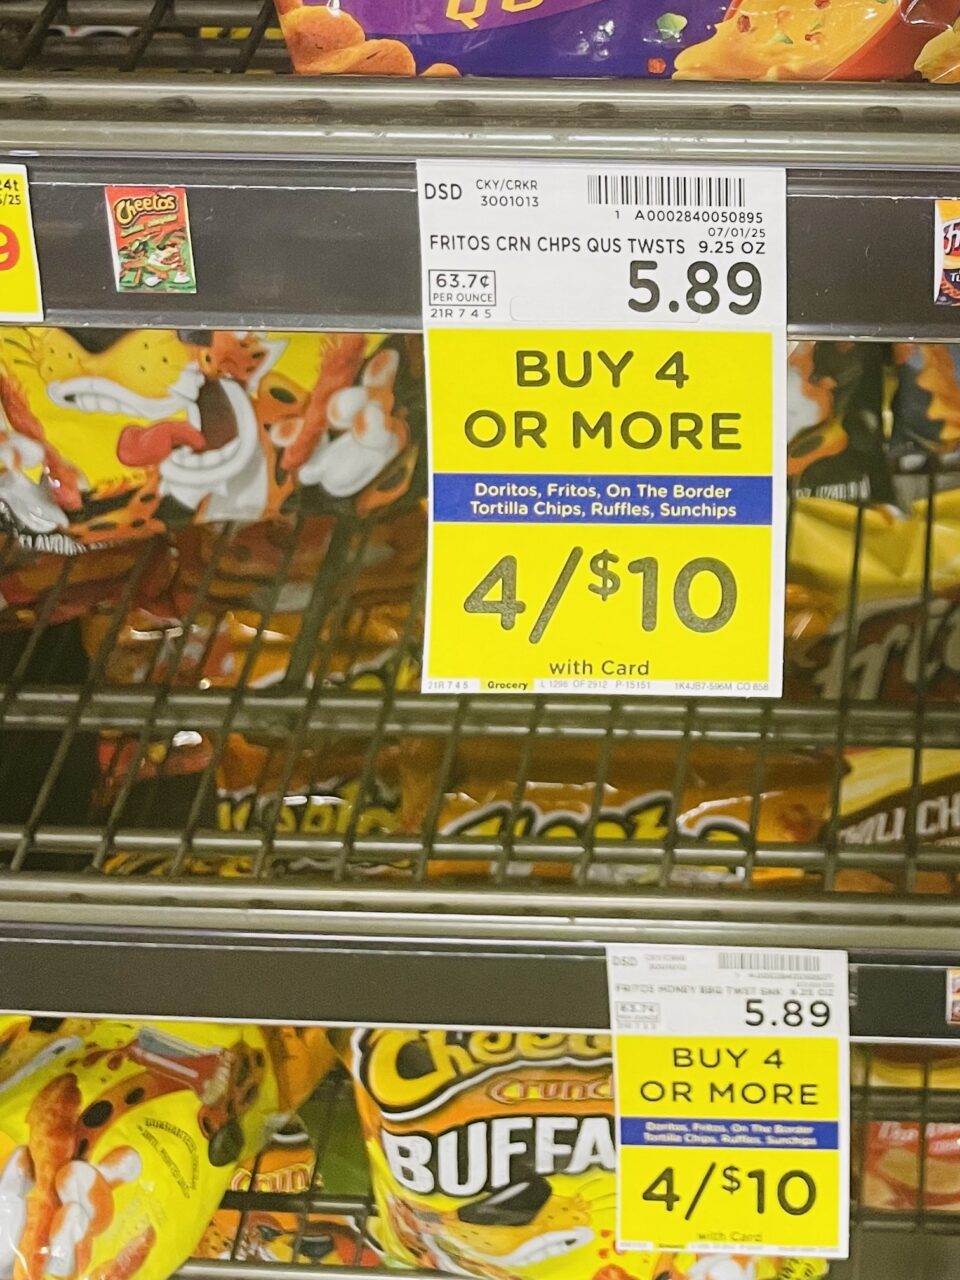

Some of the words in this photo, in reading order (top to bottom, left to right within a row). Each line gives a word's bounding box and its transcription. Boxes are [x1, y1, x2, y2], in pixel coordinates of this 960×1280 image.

[424, 183, 463, 200] DSD
[475, 179, 539, 191] CKY/CRKR
[114, 194, 176, 225] Cheetos
[480, 195, 539, 207] 3001013
[634, 210, 763, 224] A0002840050895
[707, 227, 766, 238] 07/01/25
[429, 235, 490, 251] FRITOS
[495, 236, 531, 252] CRN
[537, 237, 581, 252] CHPS
[586, 238, 622, 254] QUS
[627, 239, 686, 254] TWSTS
[698, 241, 735, 254] 9.25
[740, 240, 766, 255] OZ
[435, 272, 491, 289] 63.7¢
[627, 260, 763, 316] 5.89
[432, 292, 453, 303] PER
[456, 292, 494, 303] OUNCE
[430, 308, 453, 319] 21R
[458, 308, 466, 318] 7
[471, 308, 480, 318] 4
[515, 350, 635, 388] BUY
[654, 350, 690, 389] 4
[463, 409, 548, 449] OR
[571, 410, 743, 450] MORE
[474, 482, 543, 498] Doritos,
[547, 483, 601, 500] Fritos,
[606, 485, 632, 498] On
[636, 484, 668, 499] The
[672, 484, 732, 500] Border
[470, 501, 529, 516] Tortilla
[533, 502, 587, 519] Chips,
[590, 503, 655, 518] Ruffles,
[659, 504, 737, 519] Sunchips
[463, 545, 739, 645] 4/$10
[549, 660, 593, 676] with
[600, 660, 650, 676] Card
[487, 681, 529, 691] Grocery
[745, 999, 831, 1027] 5.89
[673, 1048, 748, 1068] BUY
[764, 1050, 783, 1069] 4
[368, 1030, 612, 1108] Chee
[640, 1082, 692, 1102] OR
[710, 1083, 819, 1105] MORE
[382, 1117, 616, 1196] BUFFA
[642, 1162, 817, 1221] 4/$10
[697, 1232, 727, 1242] with
[731, 1232, 763, 1242] Card
